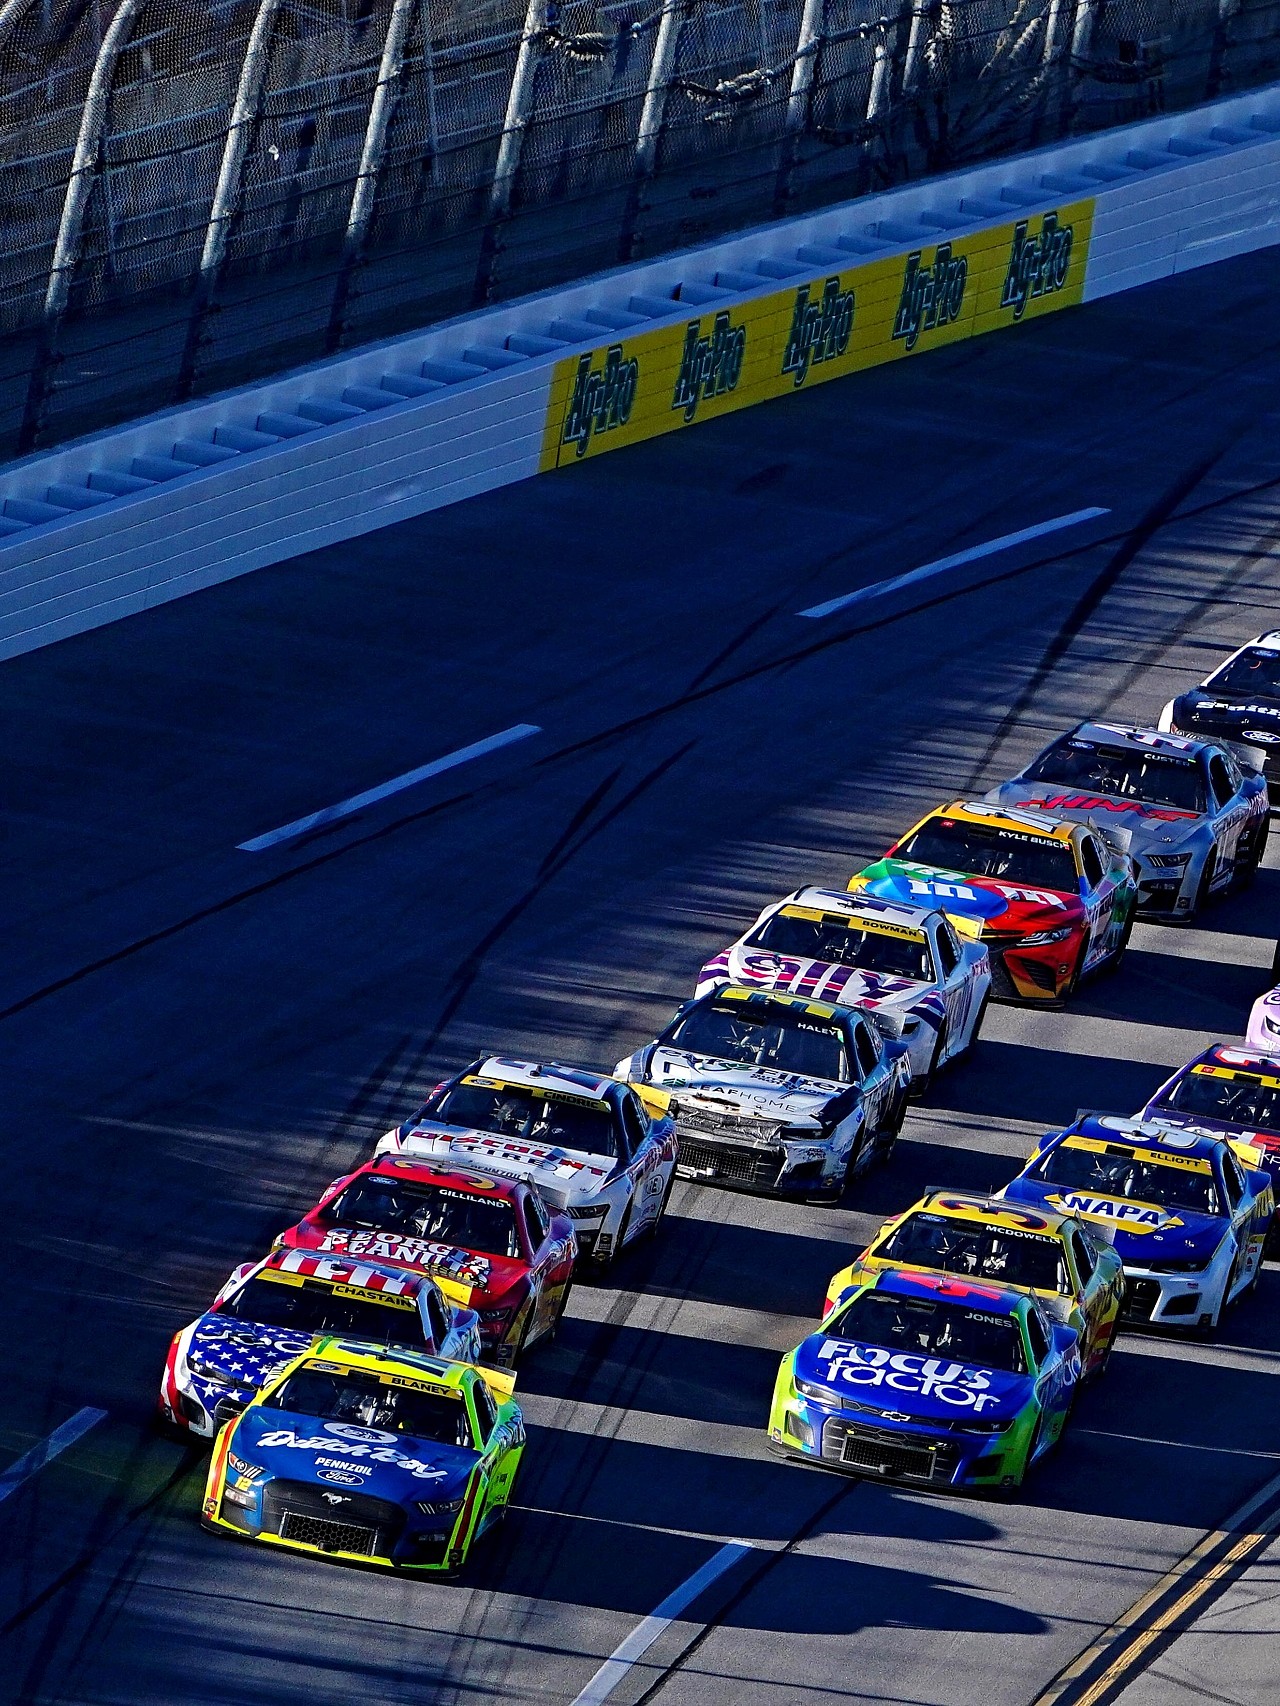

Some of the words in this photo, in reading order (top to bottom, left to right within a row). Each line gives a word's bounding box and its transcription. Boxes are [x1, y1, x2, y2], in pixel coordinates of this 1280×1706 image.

[1001, 211, 1073, 320] Ag-Pro
[892, 242, 967, 350] Ag-Pro
[782, 276, 855, 386] Ag-Pro
[672, 310, 746, 422] Ag-Pro
[561, 343, 639, 457] Ag-Pro
[1143, 753, 1191, 767] CUSTER
[998, 830, 1029, 842] KYLE
[861, 920, 917, 937] BOWMAN
[797, 1022, 837, 1036] HALEY
[543, 1091, 602, 1109] CINDRIC
[410, 1131, 609, 1177] DISCOUNT
[461, 1144, 547, 1167] TIRE
[1150, 1152, 1201, 1167] ELLIOTT
[438, 1188, 505, 1208] GILLILAND
[1066, 1195, 1160, 1226] NAPA
[985, 1224, 1058, 1245] MCDOWELL
[326, 1228, 491, 1268] GEORGIA
[335, 1285, 413, 1308] CHASTAIN
[964, 1312, 1013, 1328] JONES
[391, 1377, 451, 1396] BLANEY
[826, 1356, 1001, 1412] factor
[256, 1430, 372, 1457] Dutch
[369, 1446, 449, 1479] Boy
[314, 1456, 373, 1477] PENNZOIL
[234, 1475, 253, 1491] 12
